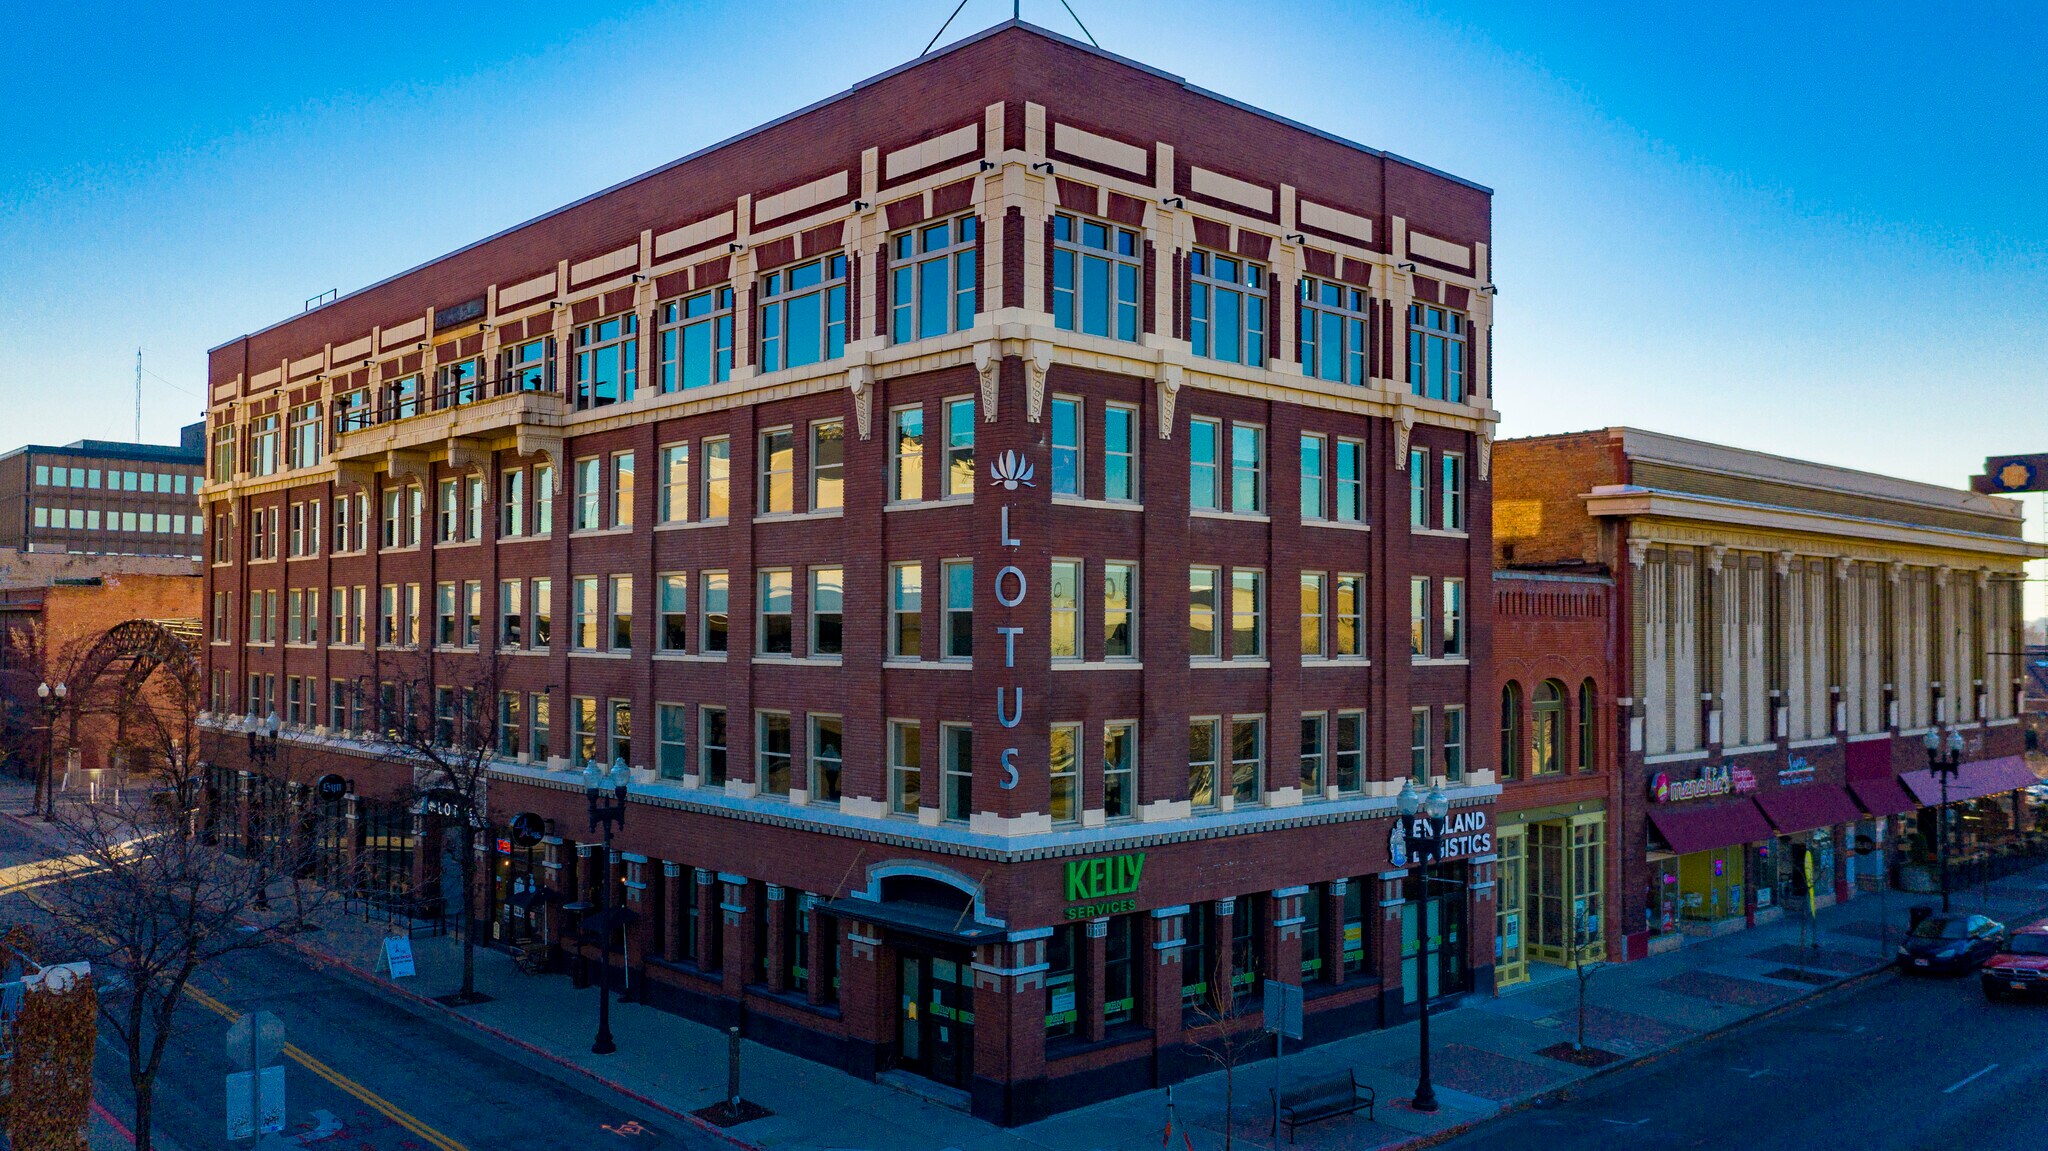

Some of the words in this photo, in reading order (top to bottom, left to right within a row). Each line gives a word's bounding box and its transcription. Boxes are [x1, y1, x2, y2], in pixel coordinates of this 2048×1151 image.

[995, 506, 1027, 790] LOTUS
[1670, 766, 1731, 801] menchie's
[1065, 852, 1146, 901] KELLY
[1066, 899, 1137, 920] SERVICES
